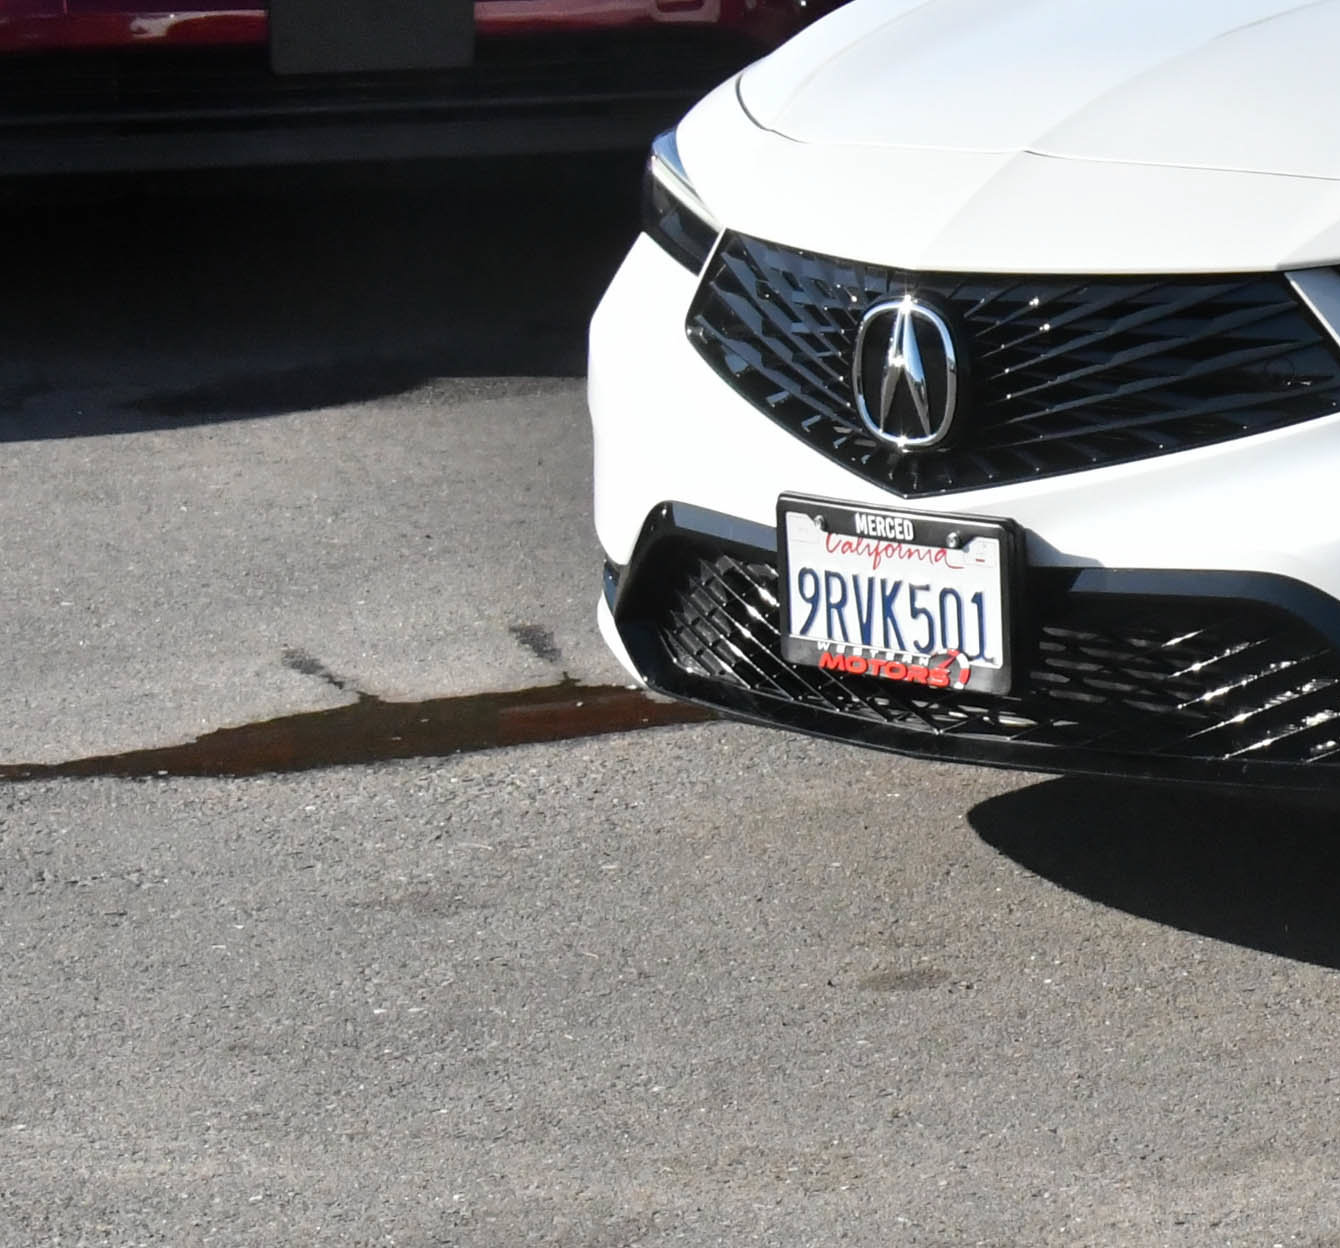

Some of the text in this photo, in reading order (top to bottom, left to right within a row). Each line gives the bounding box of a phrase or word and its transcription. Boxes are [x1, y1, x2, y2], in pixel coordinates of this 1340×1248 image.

[855, 512, 914, 541] MERCED
[825, 533, 964, 570] California
[798, 567, 996, 665] 9RVK501
[819, 652, 950, 688] MOTORS
